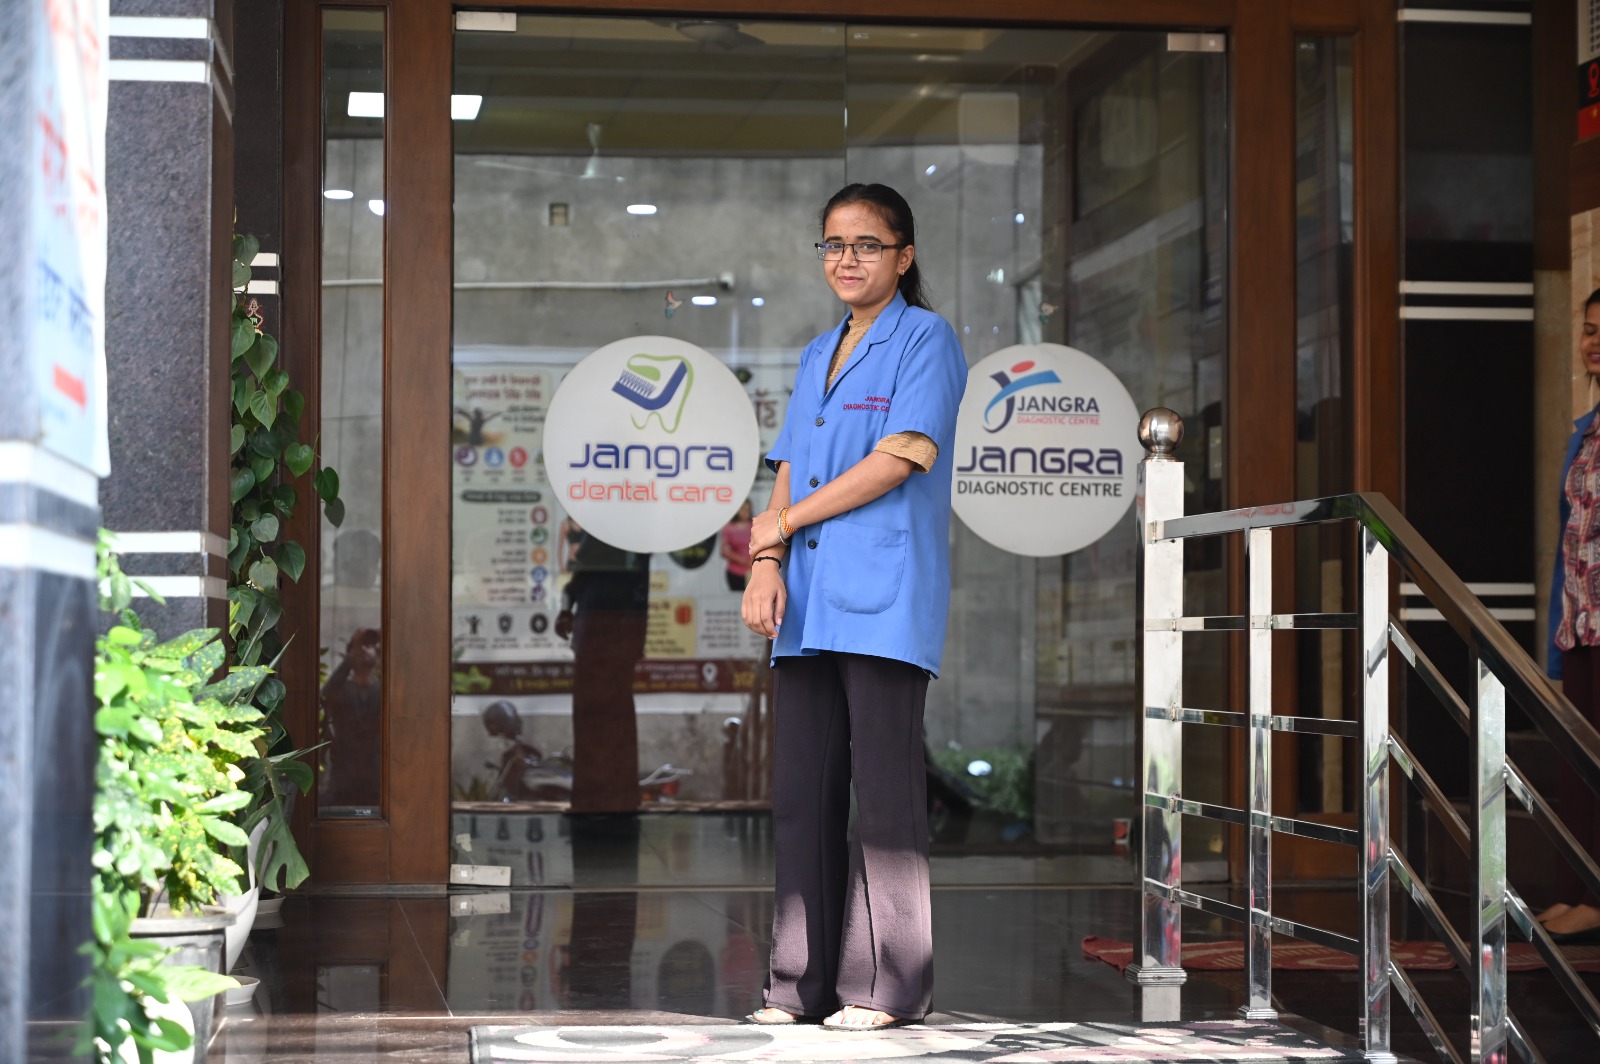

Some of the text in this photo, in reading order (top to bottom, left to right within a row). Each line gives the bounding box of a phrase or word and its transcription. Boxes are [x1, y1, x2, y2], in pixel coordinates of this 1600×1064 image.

[843, 403, 880, 411] DIAGNOSTIC
[864, 395, 890, 404] JANGRA
[1016, 395, 1100, 413] JANGRA
[1017, 415, 1100, 426] DIAGNOSTIC CENTRE
[569, 443, 733, 478] Jangra
[569, 479, 733, 503] dental care
[957, 480, 1122, 497] DIAGNOSTIC CENTRE
